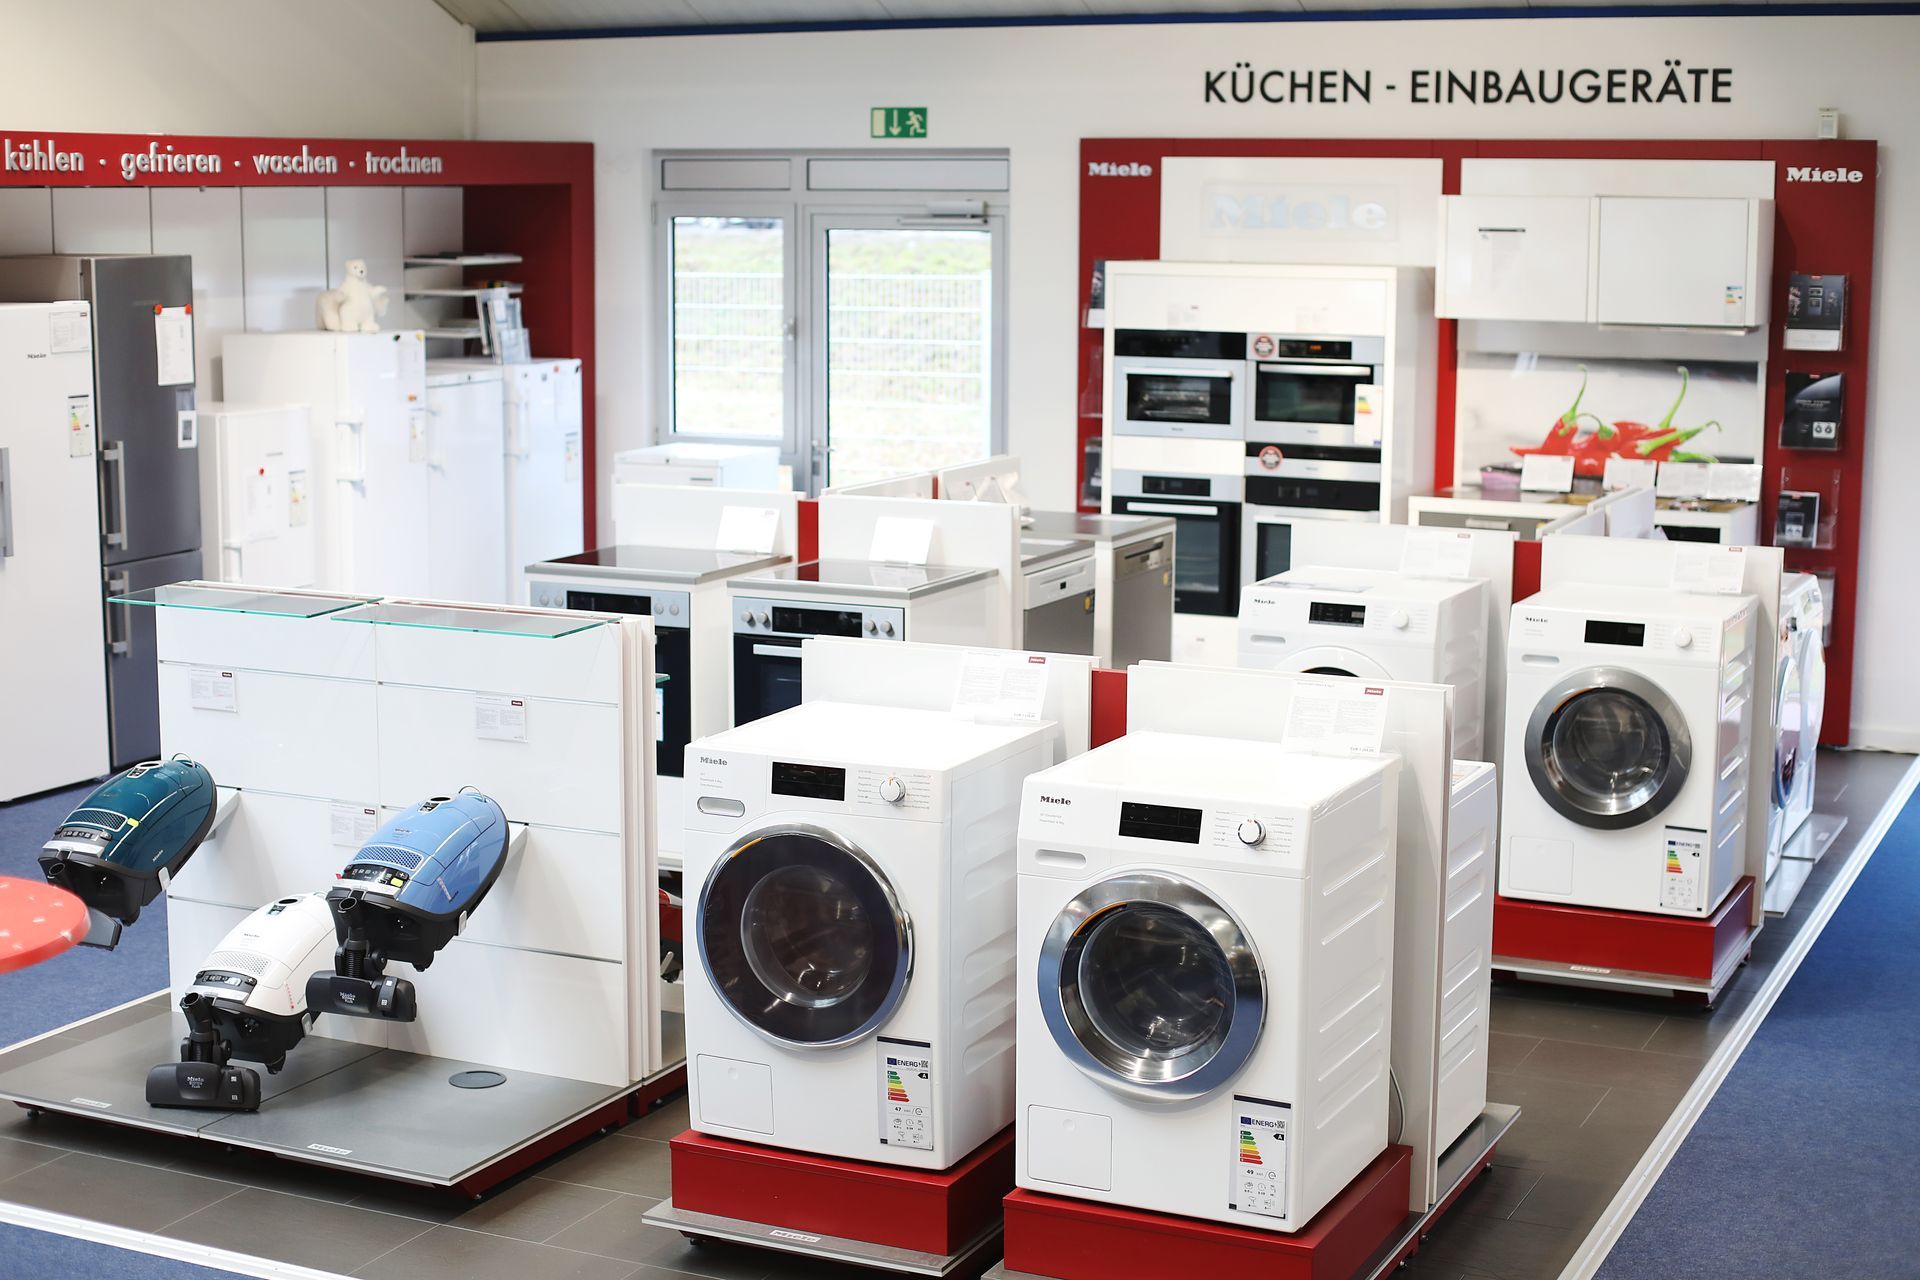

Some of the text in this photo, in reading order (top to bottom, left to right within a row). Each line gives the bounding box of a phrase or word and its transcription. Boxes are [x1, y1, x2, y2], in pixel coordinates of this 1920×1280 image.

[1204, 61, 1371, 103] KÜCHEN
[1410, 59, 1733, 104] EINBAUGERÄTE
[4, 138, 443, 181] kühlen gefrieren waschen trocknen
[1088, 161, 1152, 177] Miele
[1786, 167, 1863, 183] Miele
[1212, 194, 1388, 230] Miele
[700, 756, 728, 766] Miele
[1039, 795, 1072, 806] Miele
